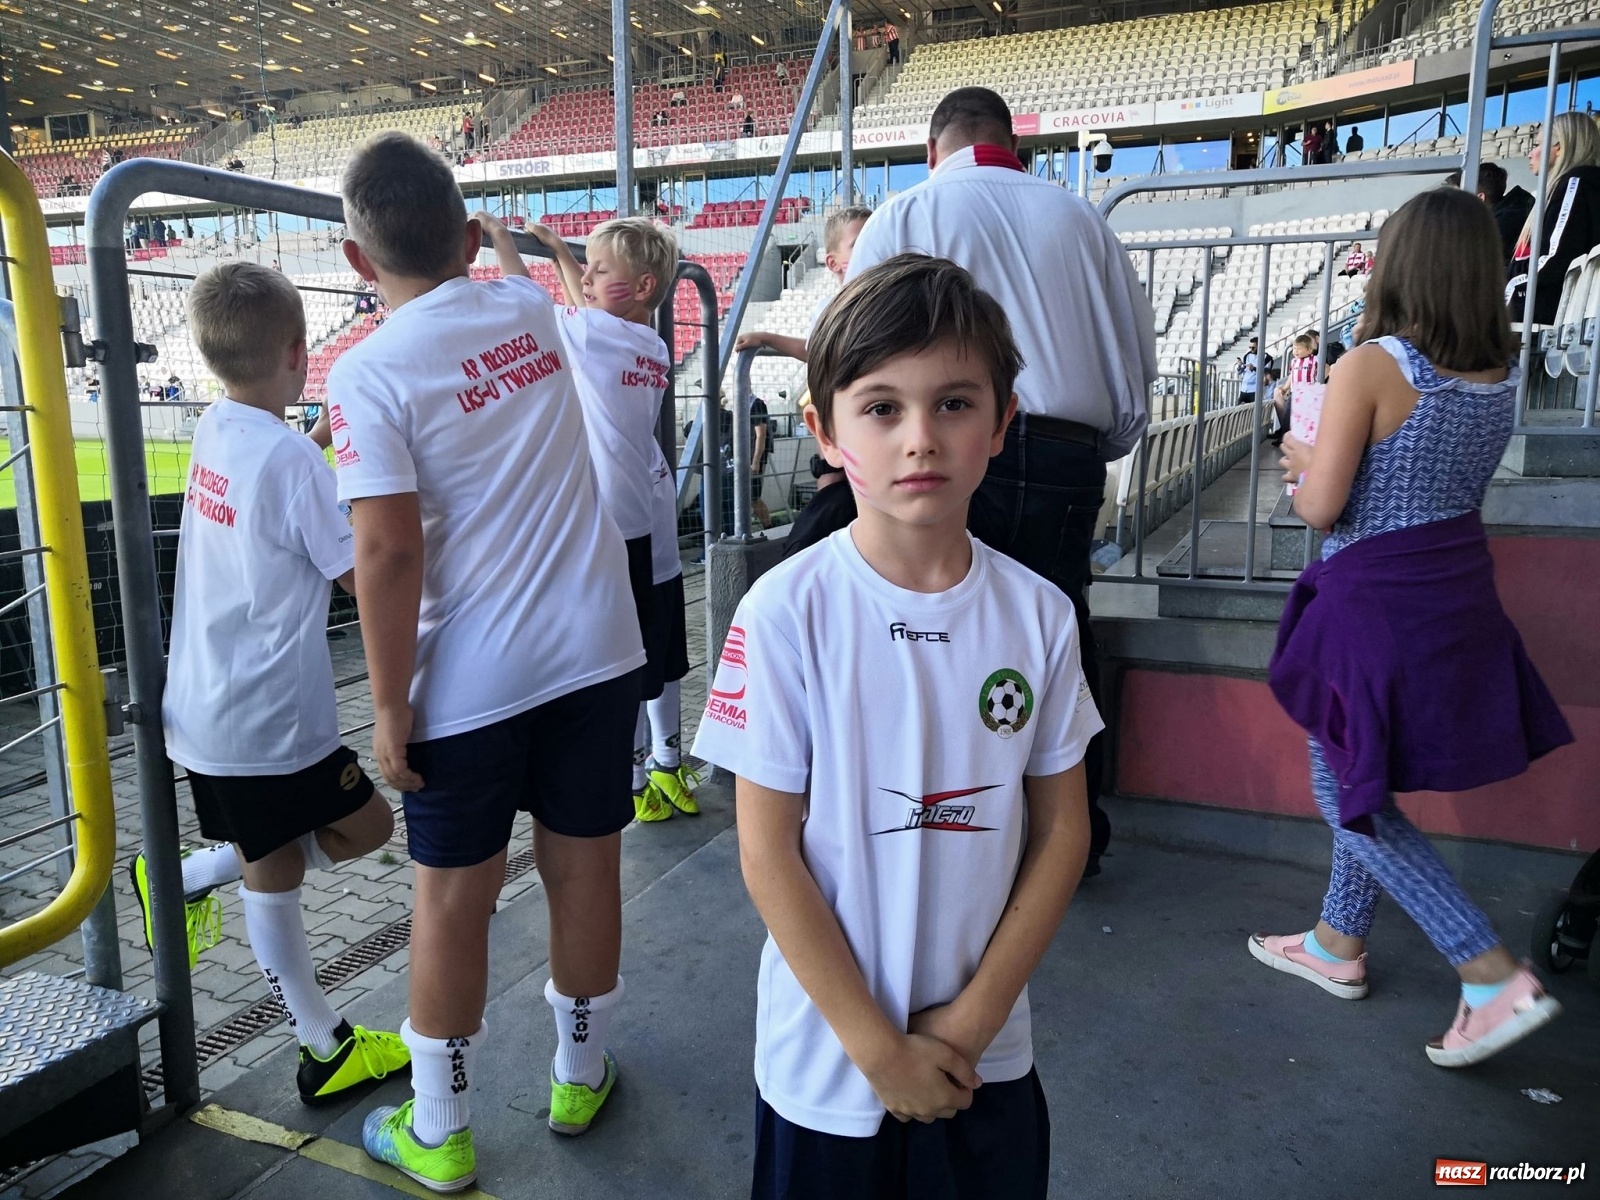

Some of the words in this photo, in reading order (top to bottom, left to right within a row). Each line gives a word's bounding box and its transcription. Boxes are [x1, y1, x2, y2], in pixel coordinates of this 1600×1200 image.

[1205, 97, 1234, 109] Light
[1053, 111, 1125, 128] CRACOVIA
[499, 160, 550, 177] STRÖER
[461, 358, 482, 381] AP
[457, 379, 501, 414] LKS-U
[498, 350, 562, 394] TWORKÓW
[621, 370, 650, 387] LKS-U
[705, 710, 746, 731] CRACOVIA
